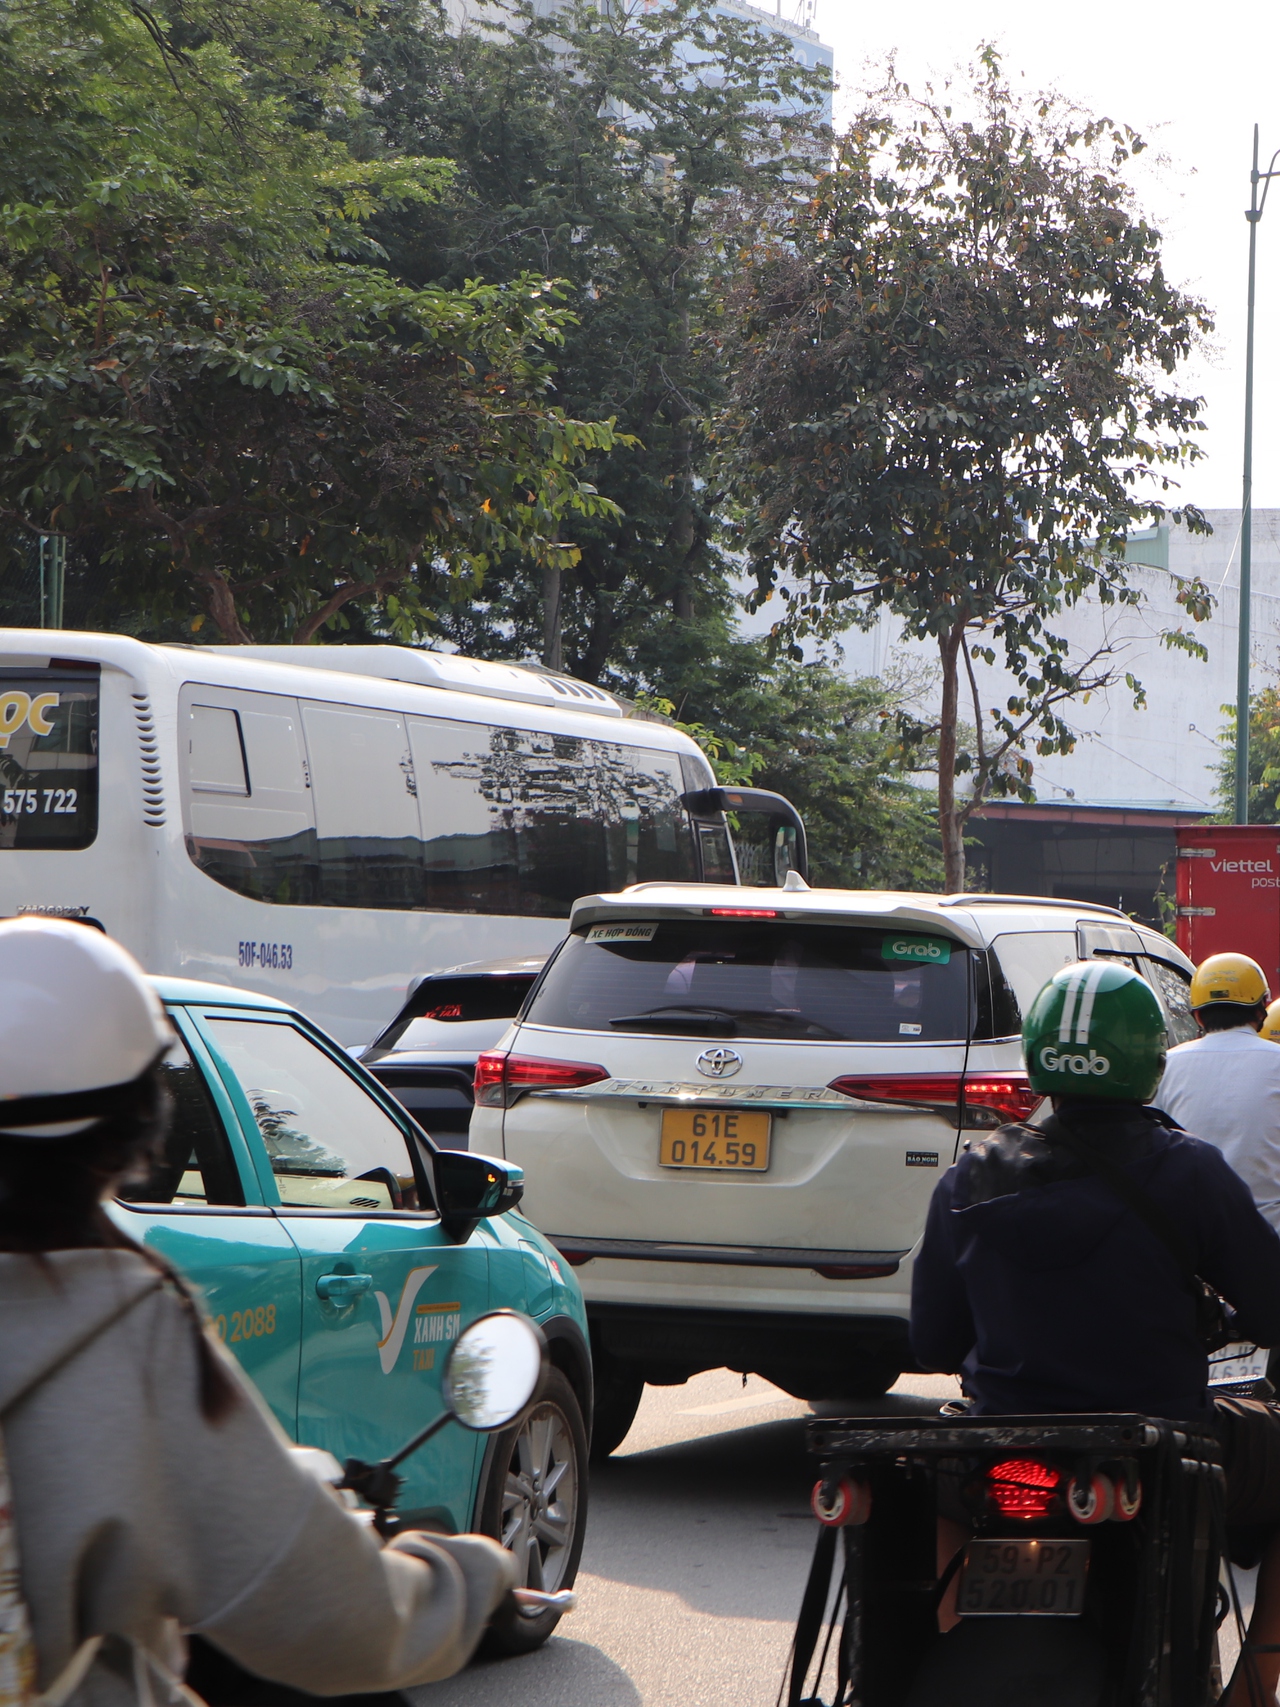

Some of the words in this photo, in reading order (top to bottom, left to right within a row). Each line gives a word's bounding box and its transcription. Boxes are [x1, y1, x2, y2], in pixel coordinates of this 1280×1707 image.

[3, 788, 38, 814] 575
[43, 788, 77, 814] 722
[1210, 858, 1273, 873] viettel
[1251, 876, 1280, 889] post
[591, 929, 604, 939] XE
[239, 941, 292, 970] 50F-046.53
[892, 941, 941, 958] Grab
[1040, 1046, 1110, 1075] Grab
[611, 1083, 822, 1099] FORTUNER
[692, 1113, 739, 1138] 61E
[671, 1140, 756, 1166] 014.59
[230, 1303, 276, 1342] 2088
[413, 1315, 444, 1344] XANH
[413, 1347, 435, 1372] TAXI
[982, 1545, 1073, 1575] 59-P2
